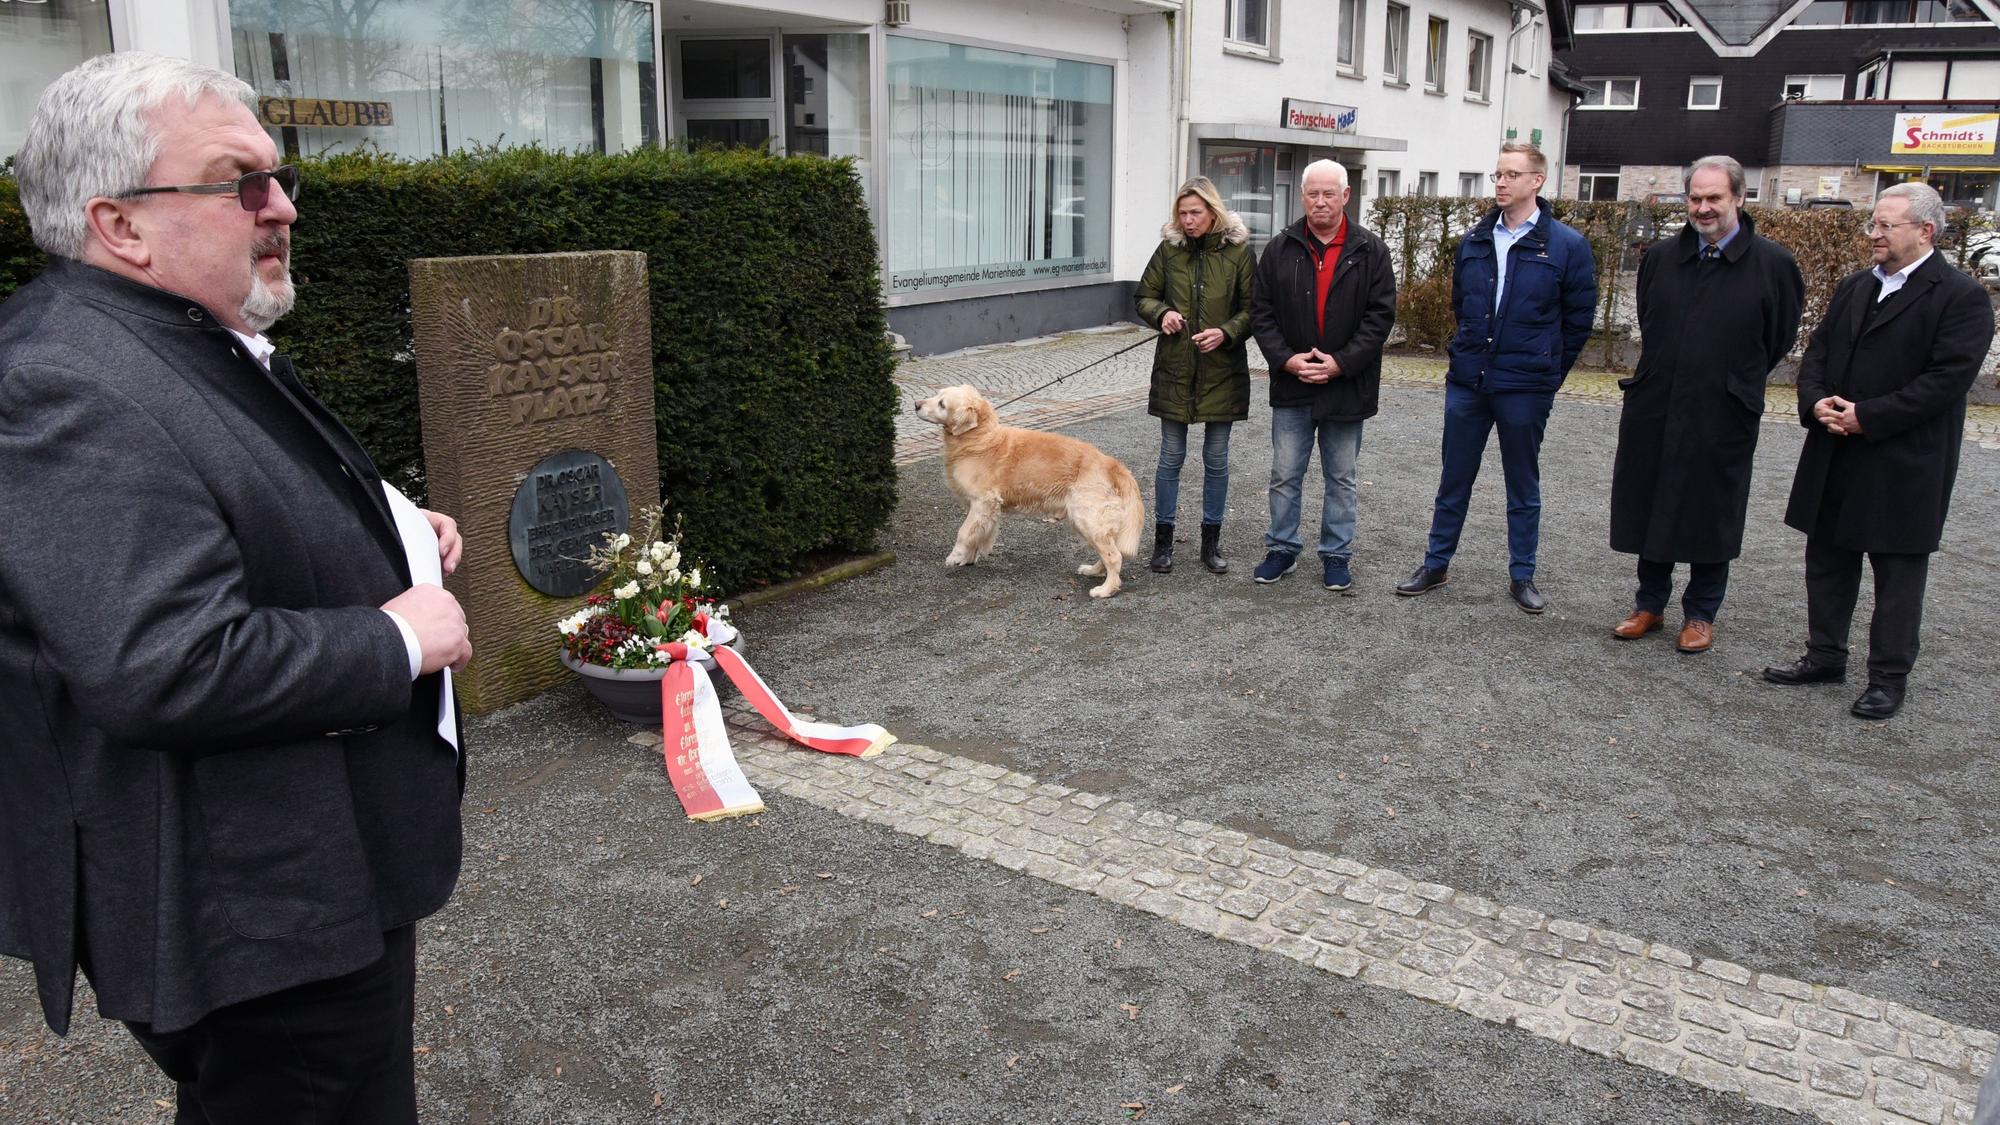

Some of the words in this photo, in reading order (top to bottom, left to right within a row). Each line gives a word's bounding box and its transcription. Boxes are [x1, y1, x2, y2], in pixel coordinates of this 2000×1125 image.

[262, 98, 393, 126] GLAUBE
[1290, 109, 1336, 129] Fahrschule
[1904, 127, 1984, 149] Schmidt's
[893, 268, 980, 290] Evangeliumsgemeinde
[982, 263, 1026, 280] Marienheide
[1033, 256, 1108, 277] www.eg-marienheide.de
[495, 323, 611, 360] OSCAR
[487, 352, 624, 397] KAYSER
[510, 383, 610, 424] PLATZ
